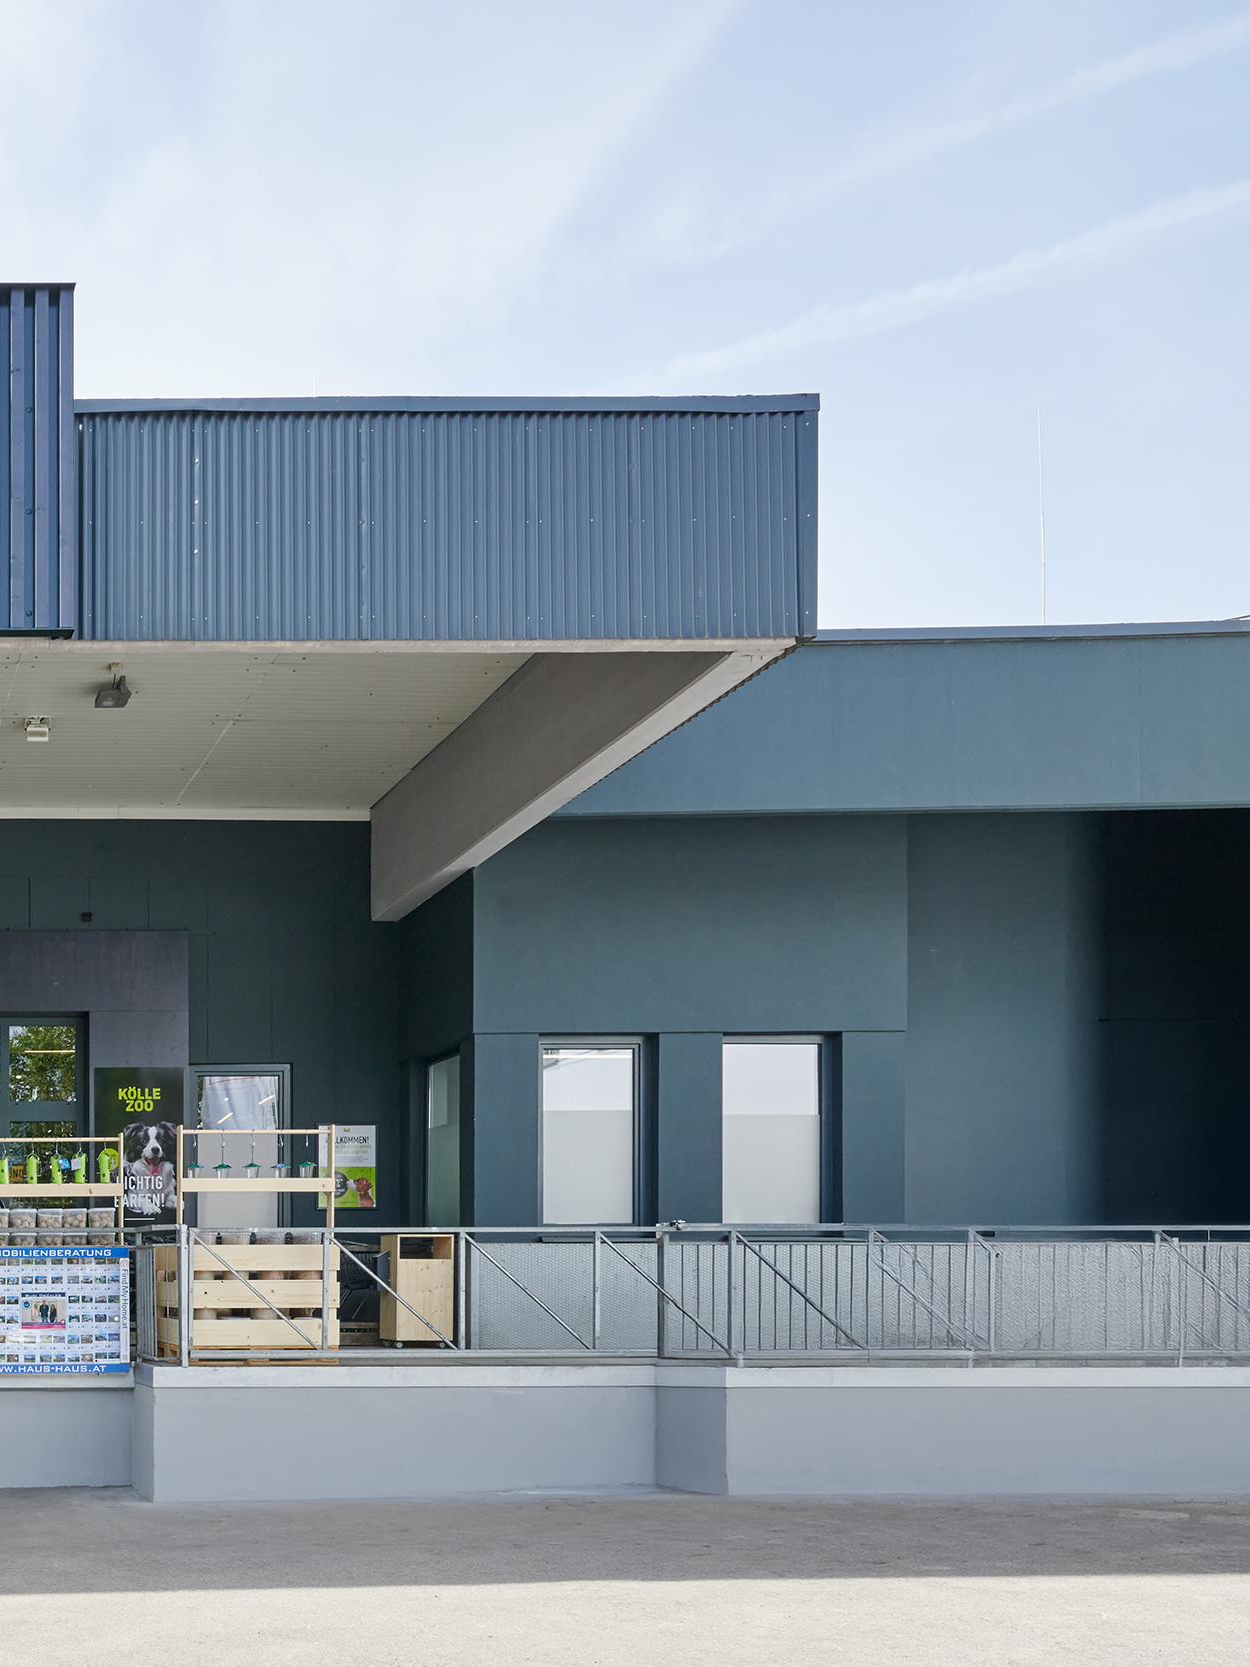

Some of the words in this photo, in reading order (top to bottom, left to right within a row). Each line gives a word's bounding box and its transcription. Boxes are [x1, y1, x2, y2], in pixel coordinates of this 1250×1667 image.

[118, 1086, 161, 1100] KÖLLE
[125, 1100, 154, 1112] ZOO
[116, 1175, 163, 1190] ICHTIG
